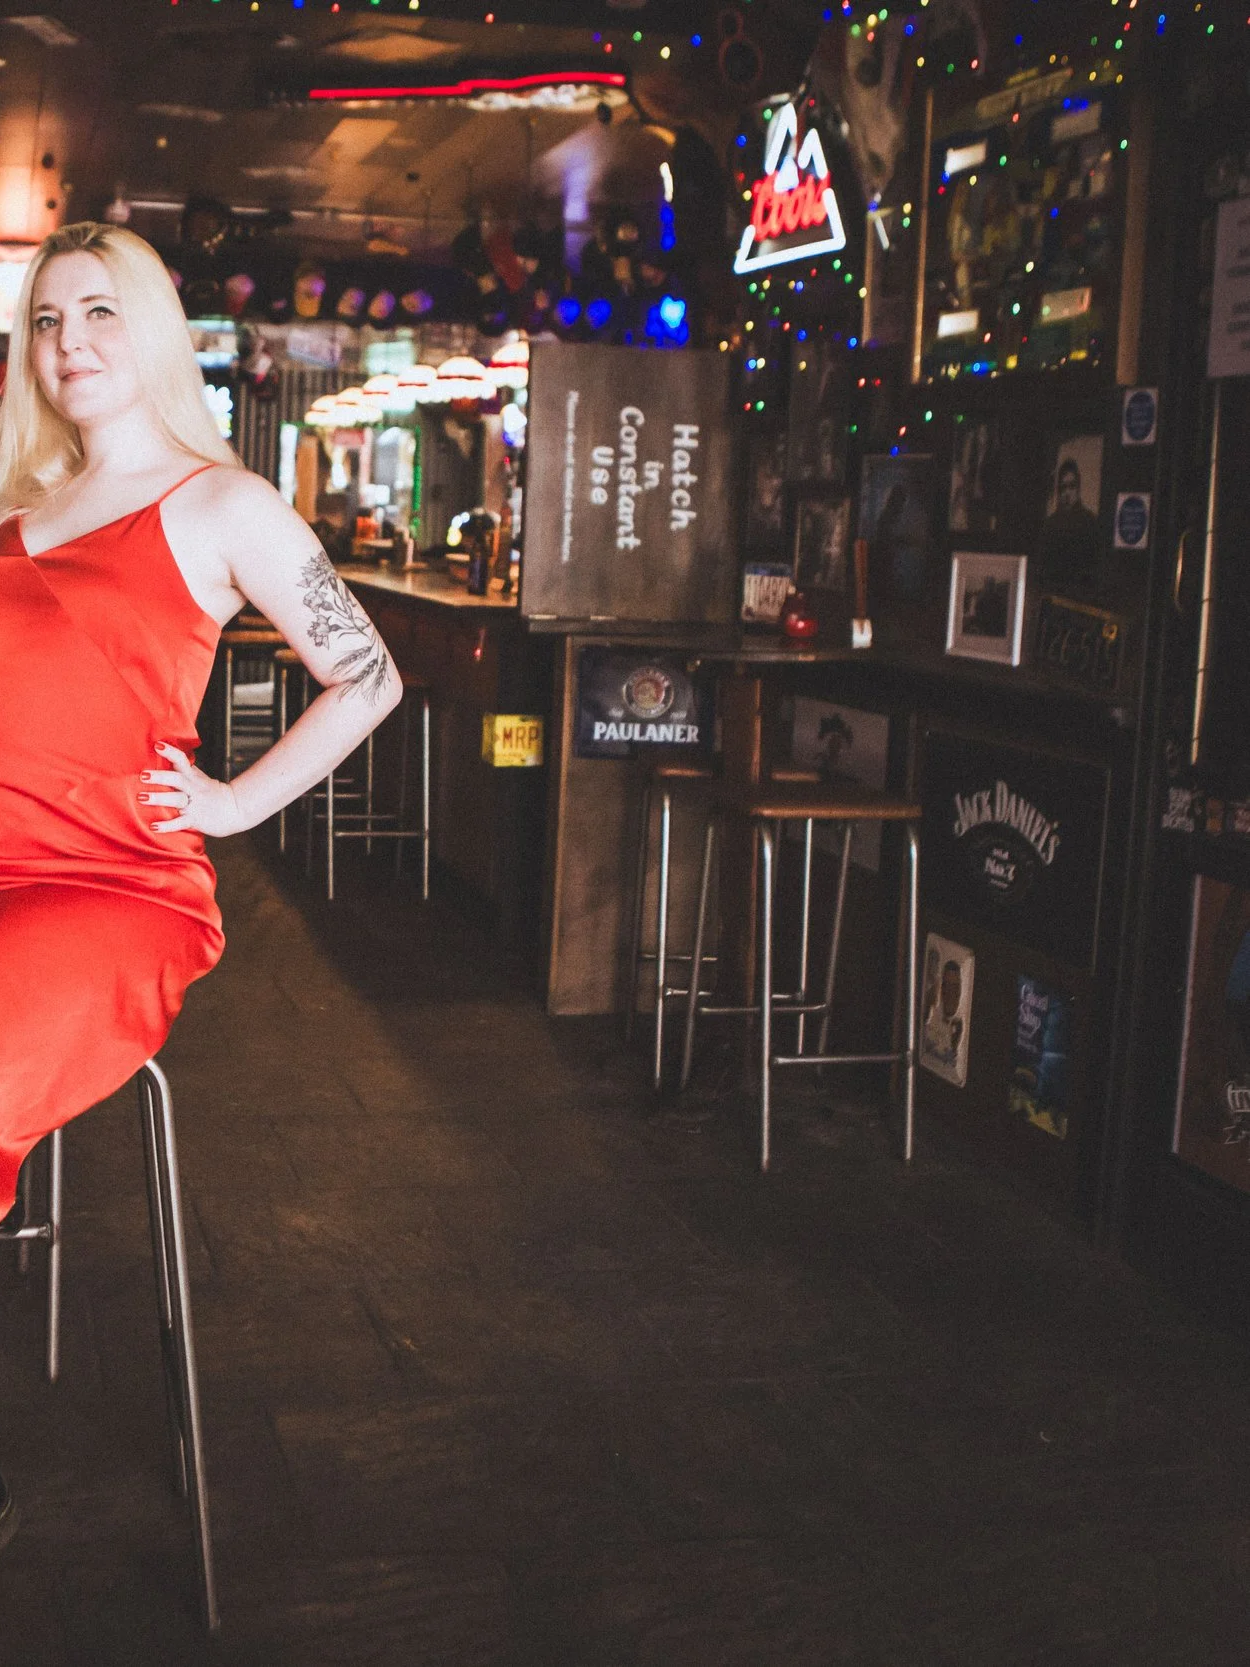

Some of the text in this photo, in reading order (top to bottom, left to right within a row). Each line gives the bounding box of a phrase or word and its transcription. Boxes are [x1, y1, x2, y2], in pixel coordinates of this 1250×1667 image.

[589, 446, 615, 506] Use
[615, 406, 645, 551] Constant
[643, 460, 665, 491] in
[669, 423, 700, 532] Hatch
[593, 721, 700, 743] PAULANER
[954, 778, 1062, 866] JACK DANIEL'S
